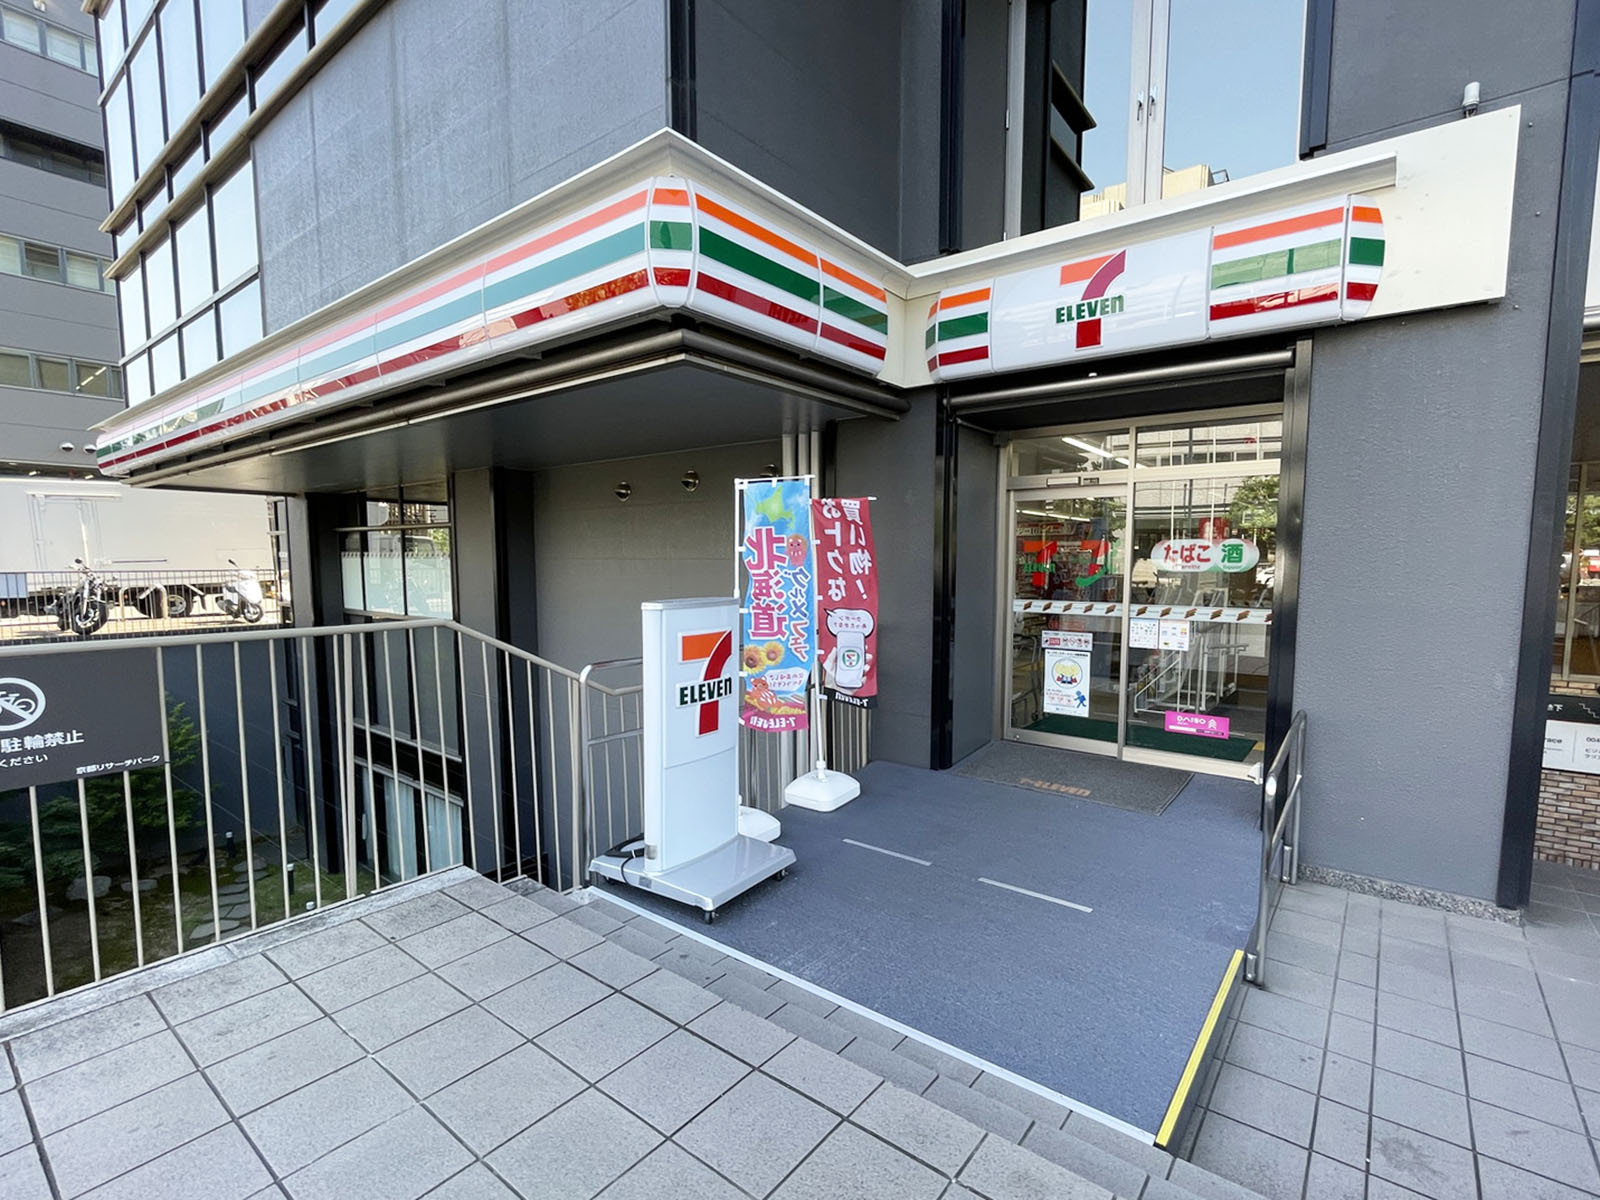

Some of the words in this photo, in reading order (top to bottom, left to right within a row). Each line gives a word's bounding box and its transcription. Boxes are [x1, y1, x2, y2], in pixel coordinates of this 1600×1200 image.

[1164, 544, 1211, 563] たばこ
[1221, 543, 1244, 563] 酒
[1176, 715, 1206, 725] DAISO
[0, 729, 84, 753] 駐輪禁止
[0, 754, 49, 768] ください
[76, 755, 160, 775] 京都リサーチパーク
